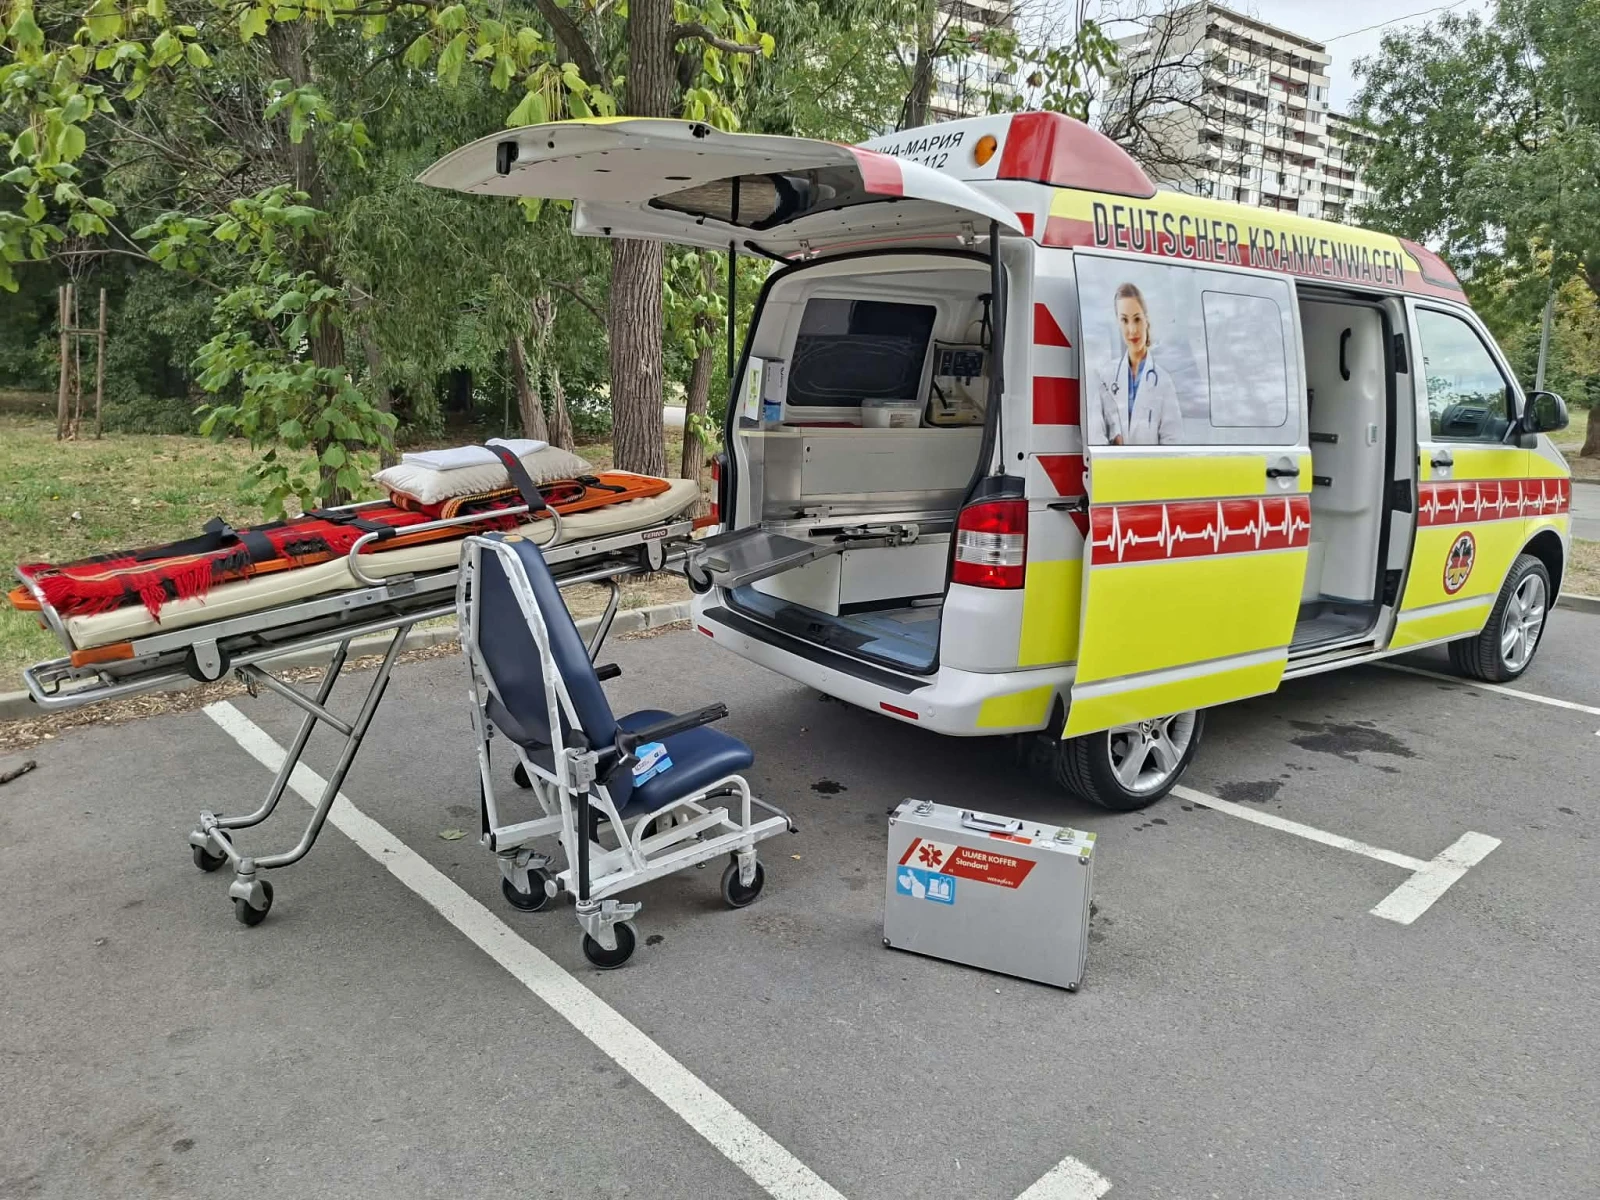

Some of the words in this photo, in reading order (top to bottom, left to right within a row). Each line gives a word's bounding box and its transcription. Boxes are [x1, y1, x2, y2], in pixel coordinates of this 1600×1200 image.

[875, 131, 965, 157] НА-МАРИЯ
[923, 152, 949, 169] 112
[1092, 201, 1242, 265] DEUTSCHER
[1248, 226, 1405, 287] KRANKENWAGEN
[643, 529, 666, 539] FERNO
[955, 857, 989, 871] Standard
[961, 849, 987, 862] ULMER
[988, 855, 1017, 868] KOFFER
